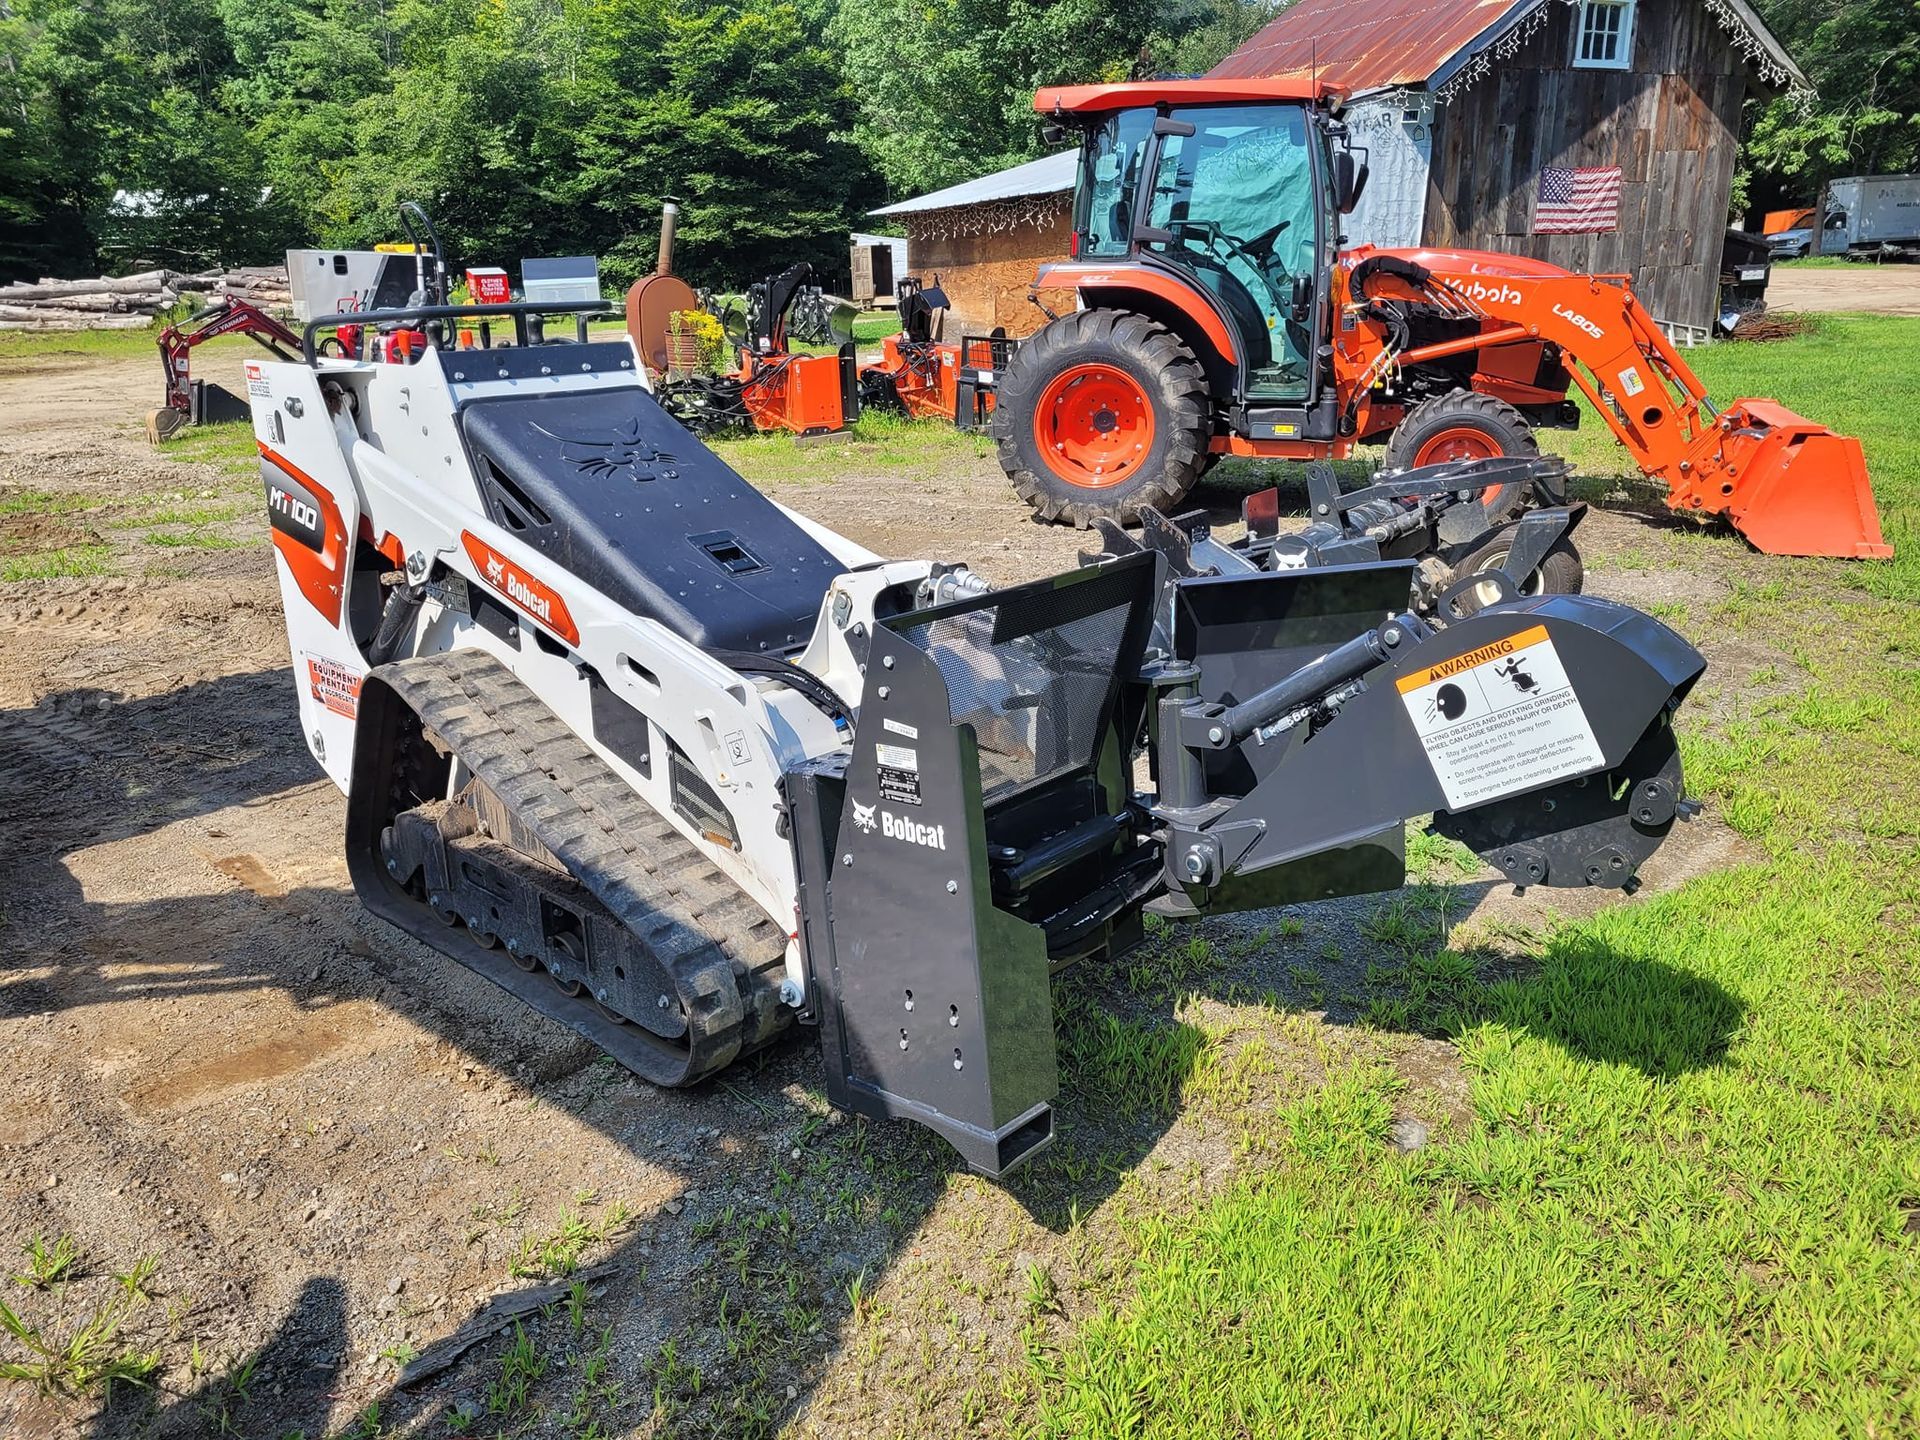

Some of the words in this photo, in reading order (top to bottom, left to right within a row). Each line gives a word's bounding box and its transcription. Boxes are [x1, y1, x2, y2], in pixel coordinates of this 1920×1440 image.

[1444, 277, 1521, 305] Kubota
[219, 314, 249, 331] YANMAR
[1552, 303, 1604, 339] LA805
[269, 486, 318, 531] MT100
[507, 572, 551, 622] Bobcat
[313, 662, 357, 685] EQUIPMENT
[320, 657, 346, 670] PLYMOUTH
[1440, 640, 1514, 676] WARNING
[320, 675, 351, 694] RENTAL
[1426, 732, 1449, 744] FLYING
[1450, 721, 1481, 736] OBJECTS
[1482, 716, 1497, 726] AND
[1497, 703, 1533, 720] ROTATING
[1534, 690, 1571, 708] GRINDING
[1426, 741, 1449, 752] WHEEL
[1449, 735, 1464, 745] CAN
[1464, 728, 1486, 740] CAUSE
[1486, 718, 1515, 732] SERIOUS
[1516, 709, 1540, 723] INJURY
[1541, 705, 1552, 714] OR
[1552, 697, 1577, 711] DEATH
[1445, 750, 1460, 758] Stay
[1467, 741, 1483, 750] least
[1497, 732, 1508, 742] (12
[1508, 730, 1516, 738] ft)
[1517, 725, 1534, 735] away
[1534, 719, 1552, 728] from
[1454, 770, 1464, 778] Do
[1476, 759, 1501, 771] operate
[1502, 754, 1515, 763] with
[1516, 743, 1548, 759] damaged
[1556, 733, 1584, 746] missing
[1449, 752, 1479, 766] operating
[1458, 774, 1484, 785] screens,
[1484, 766, 1508, 777] shields
[1516, 755, 1538, 767] rubber
[1539, 745, 1576, 760] deflectors.
[1463, 789, 1479, 798] Stop
[1479, 783, 1501, 793] engine
[1501, 776, 1523, 787] before
[1523, 766, 1552, 780] cleaning
[1560, 755, 1594, 769] servicing.
[881, 811, 946, 850] Bobcat
